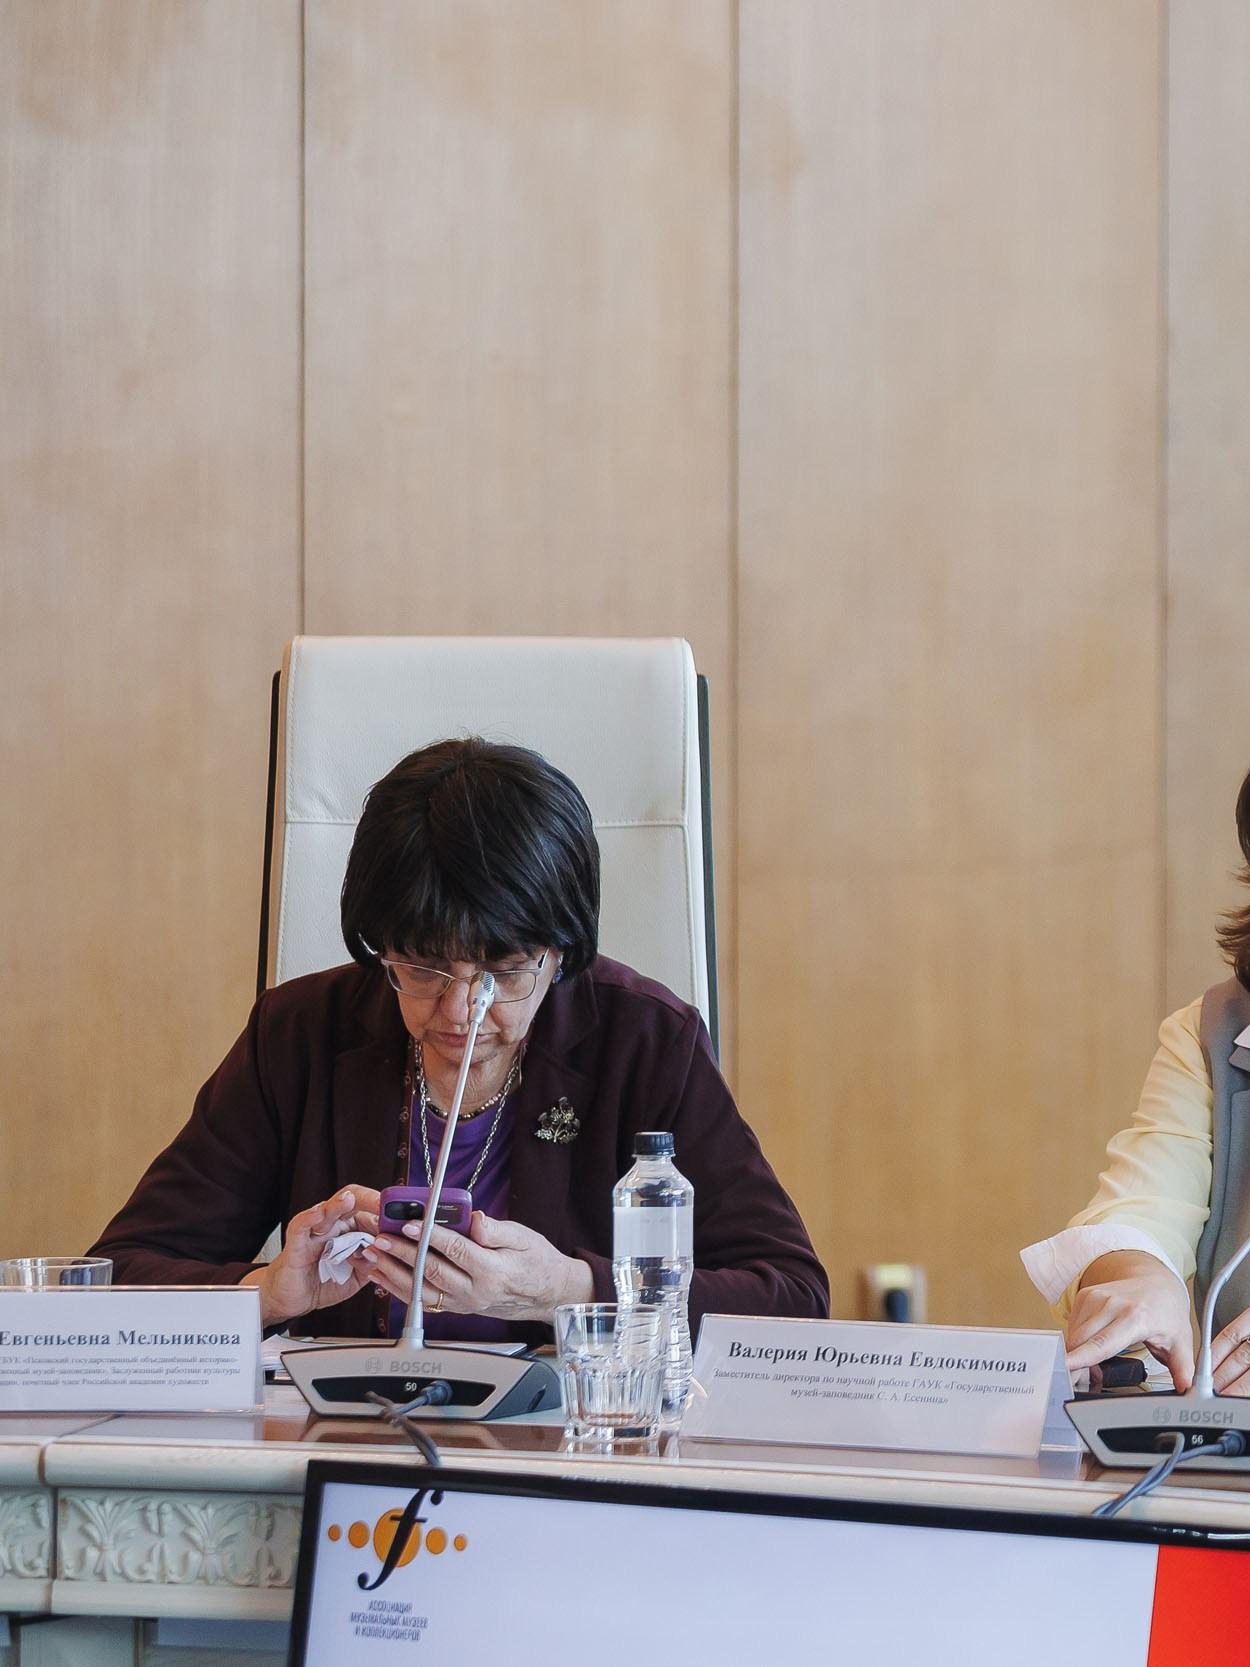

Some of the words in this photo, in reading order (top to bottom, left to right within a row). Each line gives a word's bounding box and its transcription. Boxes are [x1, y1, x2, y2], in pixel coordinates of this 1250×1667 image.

[0, 1330, 110, 1346] Евгеньевна
[117, 1330, 241, 1346] Мельникова
[728, 1340, 808, 1364] Валерия
[814, 1345, 903, 1369] Юрьевна
[909, 1350, 1028, 1374] Евдокимова
[389, 1360, 443, 1374] BOSCH
[404, 1381, 418, 1393] 50
[712, 1367, 770, 1380] Заместитель
[772, 1372, 821, 1385] директора
[823, 1375, 835, 1384] по
[836, 1376, 876, 1388] научной
[877, 1376, 910, 1388] работе
[912, 1378, 944, 1390] ГАУК
[944, 1380, 1036, 1396] «Государственный
[1178, 1409, 1235, 1425] BOSCH
